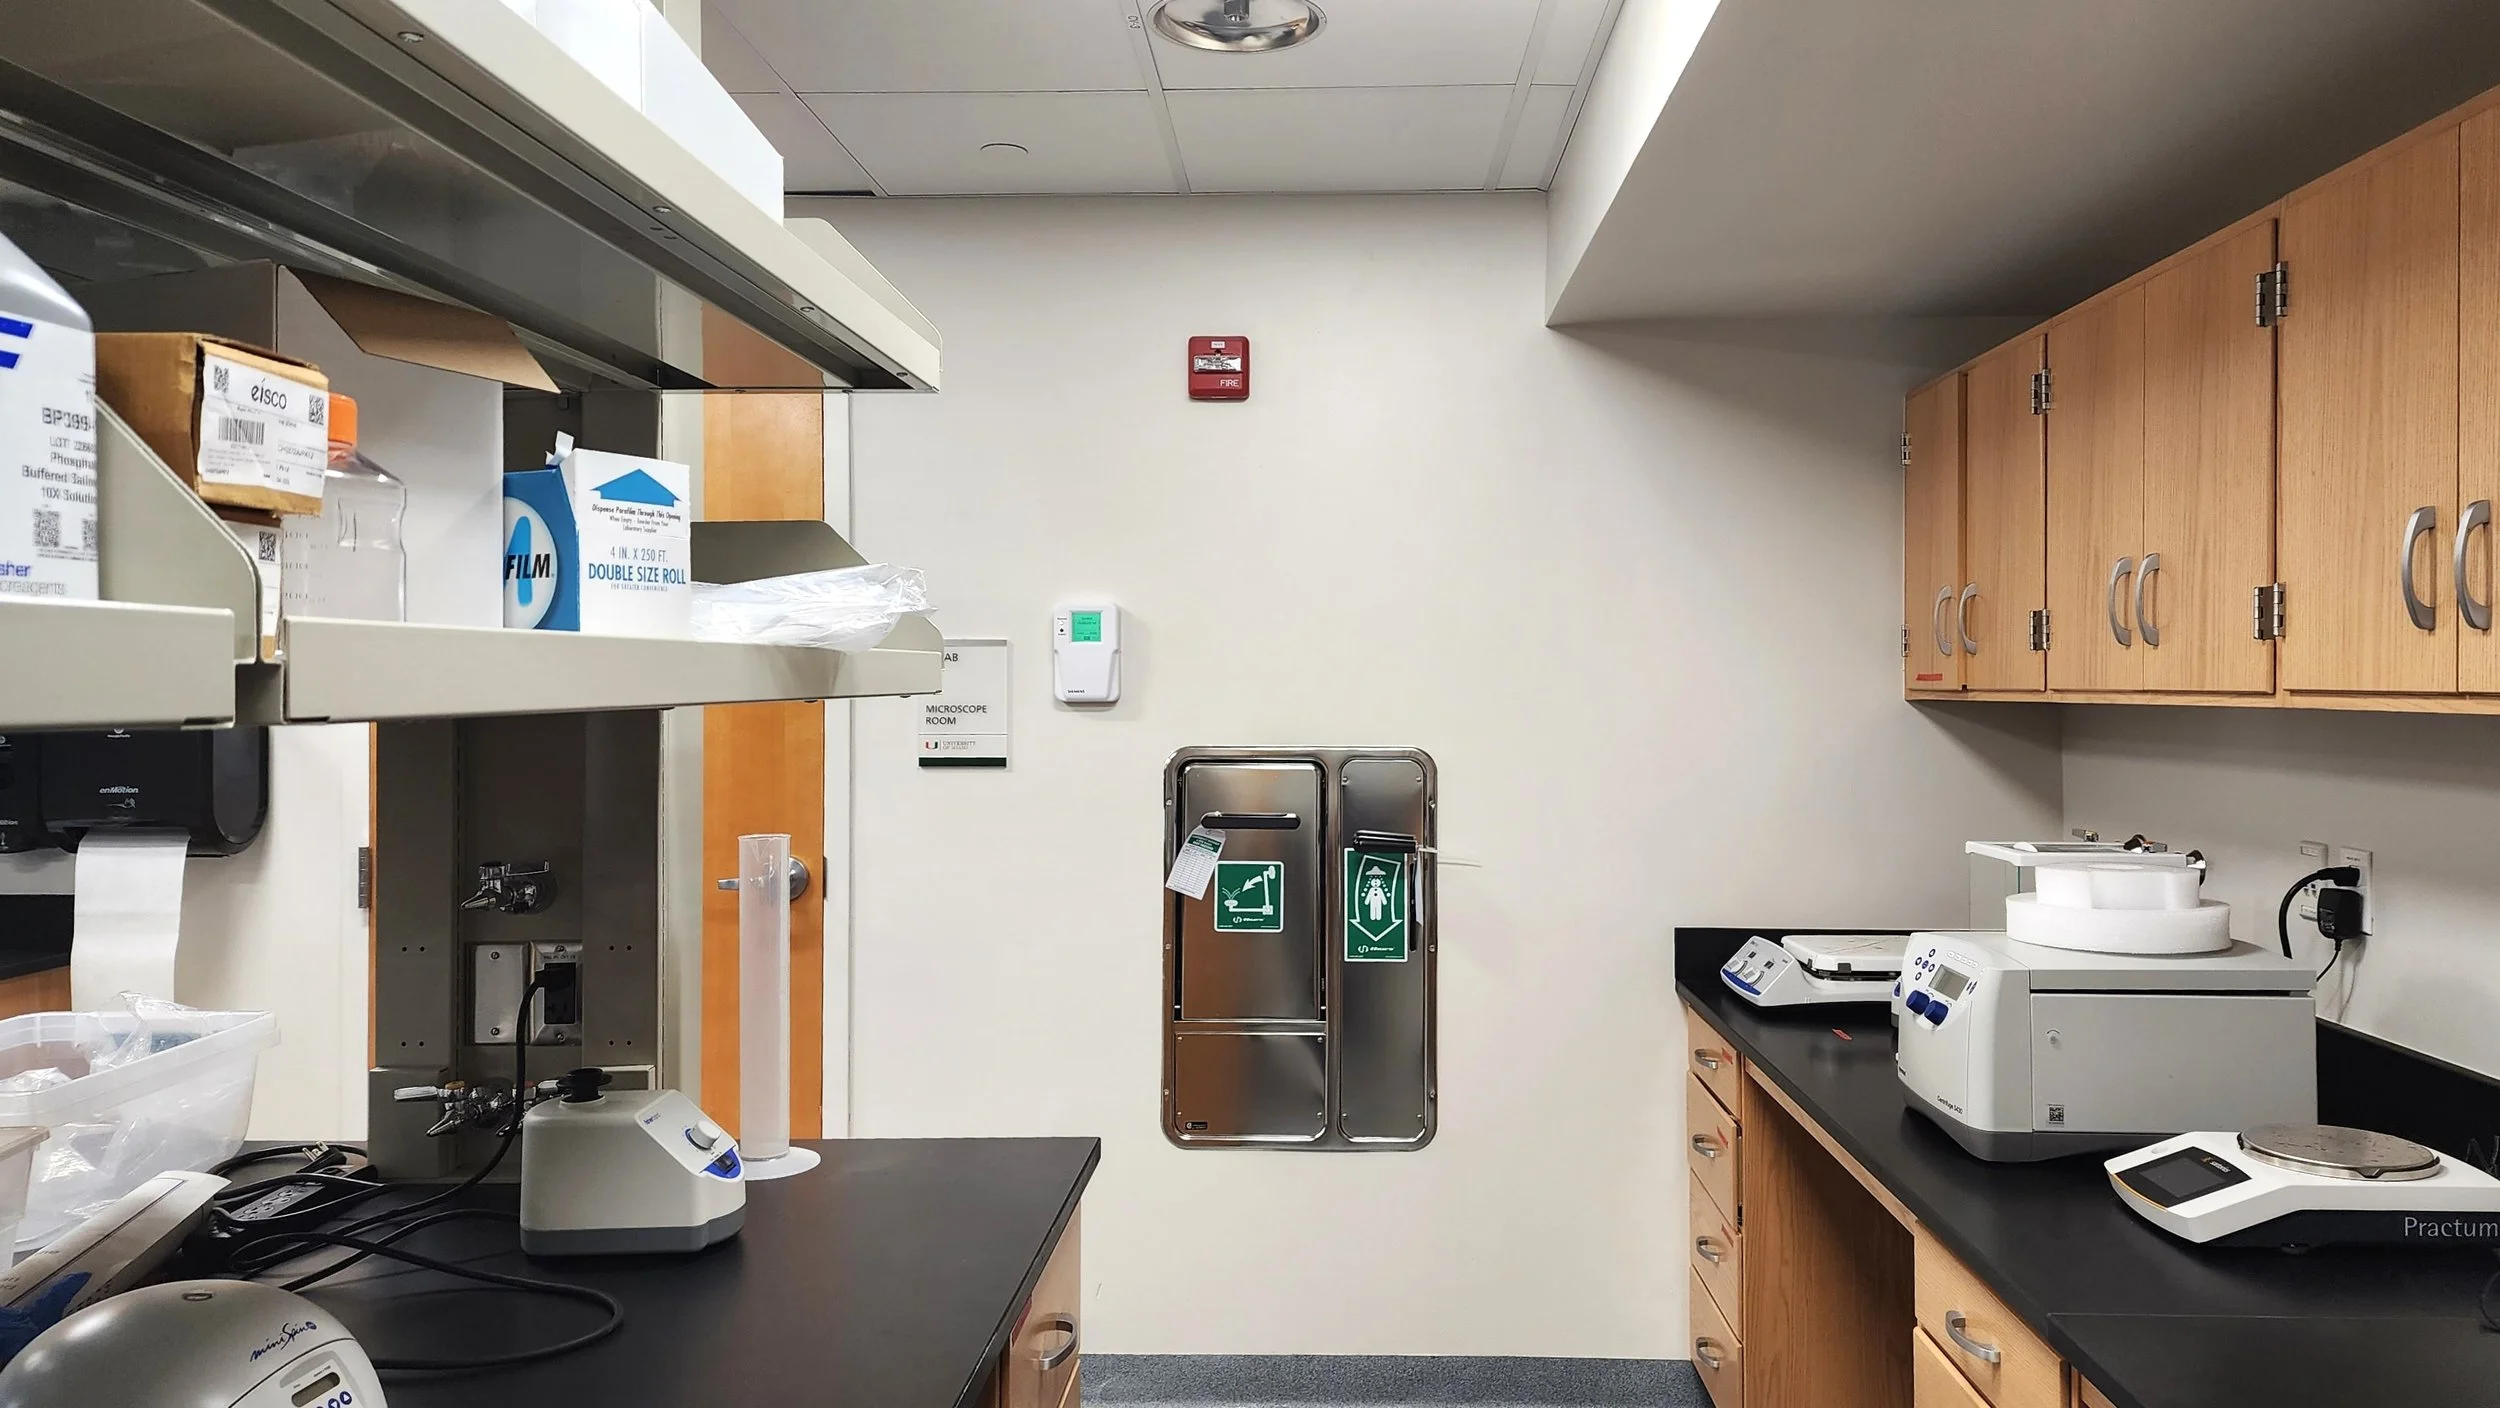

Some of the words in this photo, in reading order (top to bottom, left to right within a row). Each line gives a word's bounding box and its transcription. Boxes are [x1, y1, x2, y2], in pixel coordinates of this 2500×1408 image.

[1220, 379, 1239, 387] FIRE
[251, 377, 288, 410] eisco
[22, 465, 67, 483] Buffered
[610, 546, 616, 559] 4
[619, 547, 630, 560] IN.
[633, 547, 638, 560] X
[641, 548, 656, 561] 250
[658, 549, 669, 563] FT.
[588, 562, 634, 582] DOUBLE
[637, 565, 659, 583] SIZE
[663, 567, 686, 585] ROLL
[944, 652, 959, 662] AB
[925, 704, 987, 714] MICROSCOPE
[925, 716, 956, 725] ROOM
[100, 786, 139, 794] enMotion
[2404, 1216, 2499, 1238] Practum
